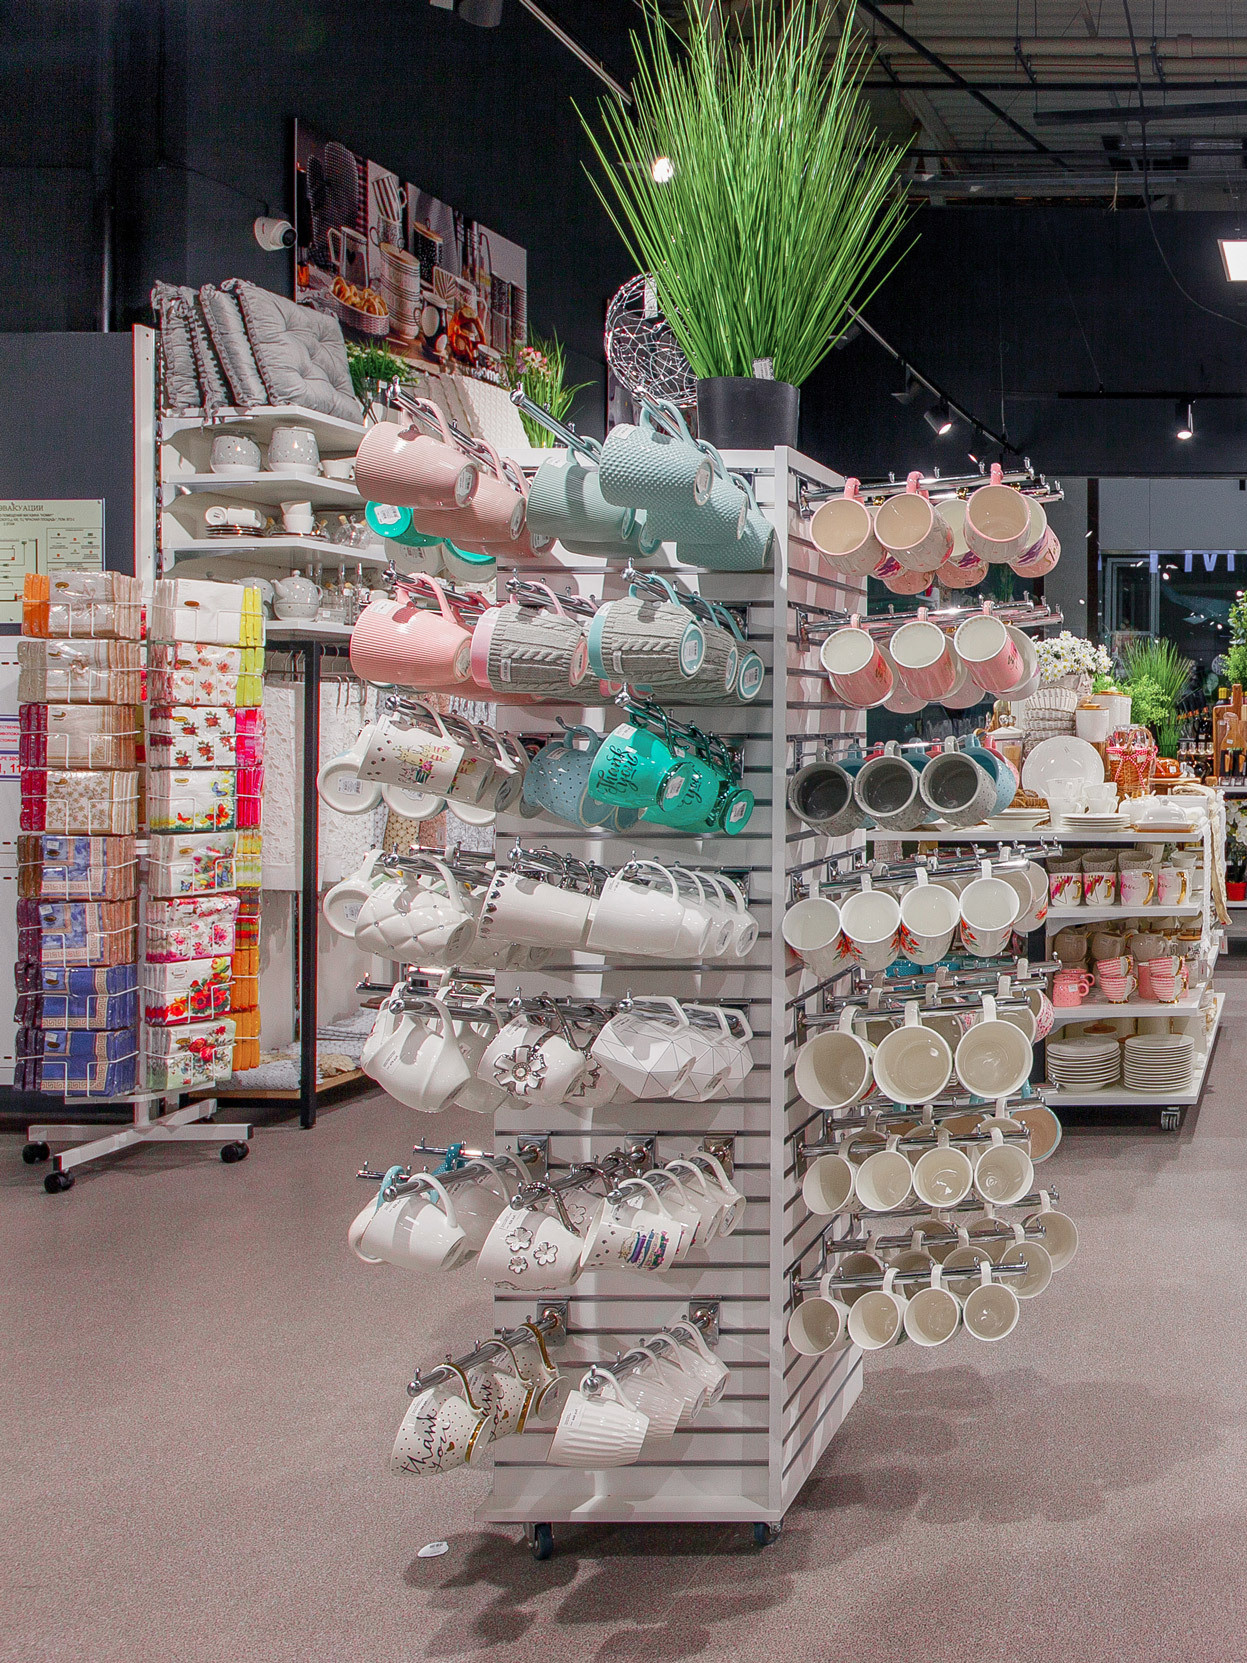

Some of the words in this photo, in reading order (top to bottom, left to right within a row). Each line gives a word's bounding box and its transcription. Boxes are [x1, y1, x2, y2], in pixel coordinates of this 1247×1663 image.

[596, 745, 629, 795] Thank
[480, 1381, 493, 1417] ank
[400, 1408, 438, 1475] thank
